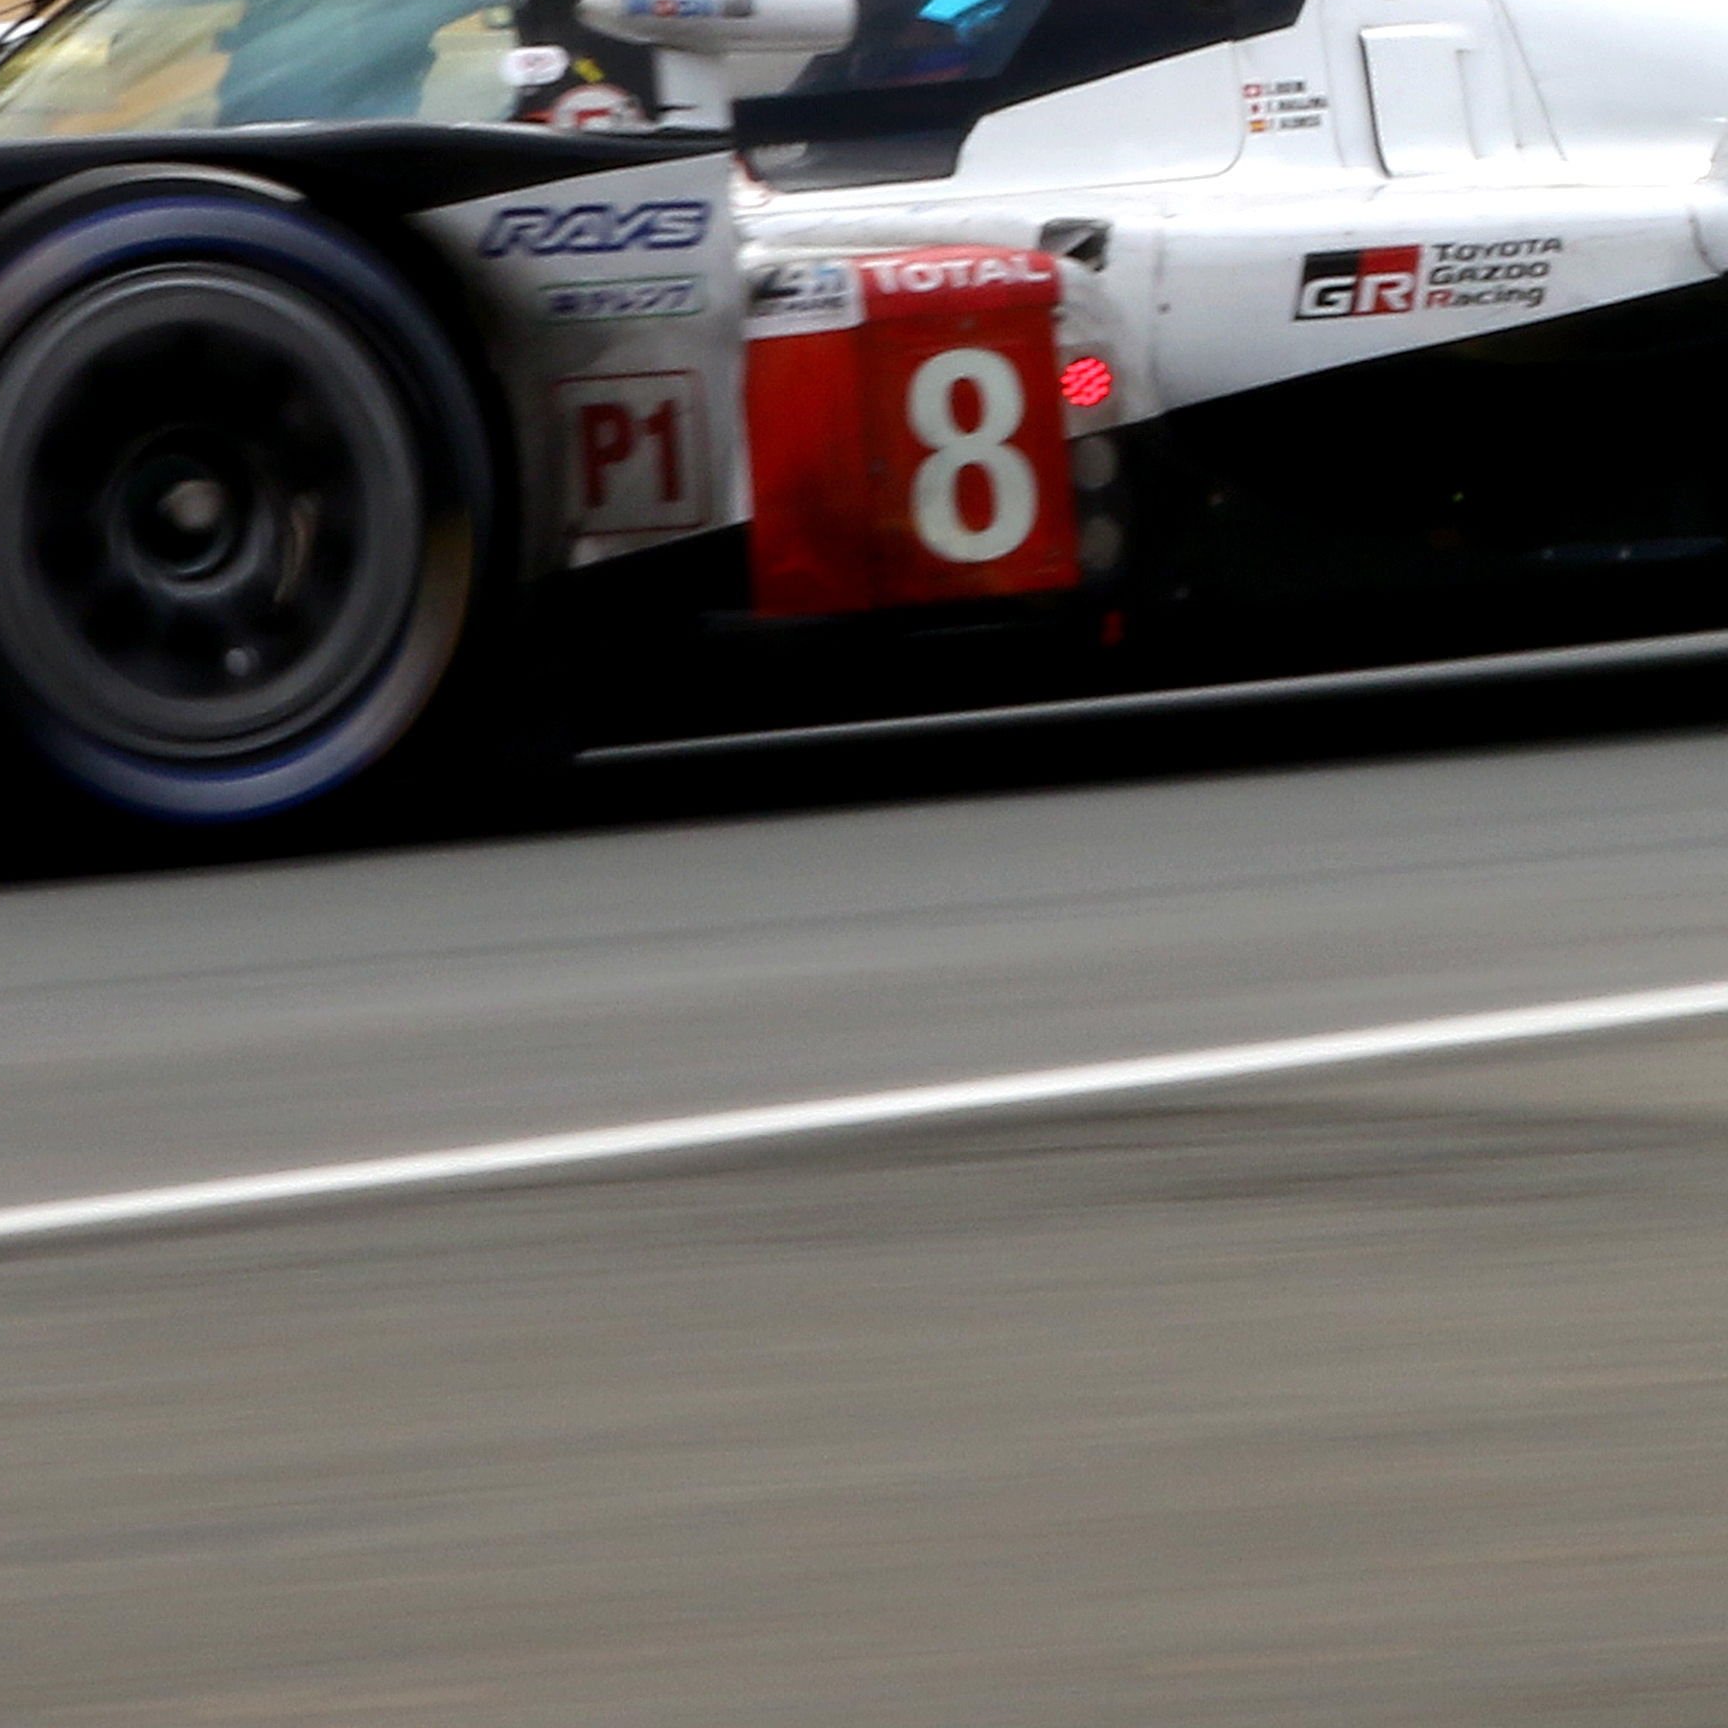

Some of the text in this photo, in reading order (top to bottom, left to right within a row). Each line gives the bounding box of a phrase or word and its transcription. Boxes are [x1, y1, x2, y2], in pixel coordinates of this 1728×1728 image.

[477, 201, 712, 257] RAYS
[1430, 237, 1564, 262] TOYOTA
[860, 255, 1052, 294] TOTAL
[1429, 261, 1551, 285] GAZOO
[1299, 272, 1416, 317] GR
[1425, 286, 1545, 308] Racing
[578, 398, 684, 510] P1
[908, 347, 1039, 563] 8
